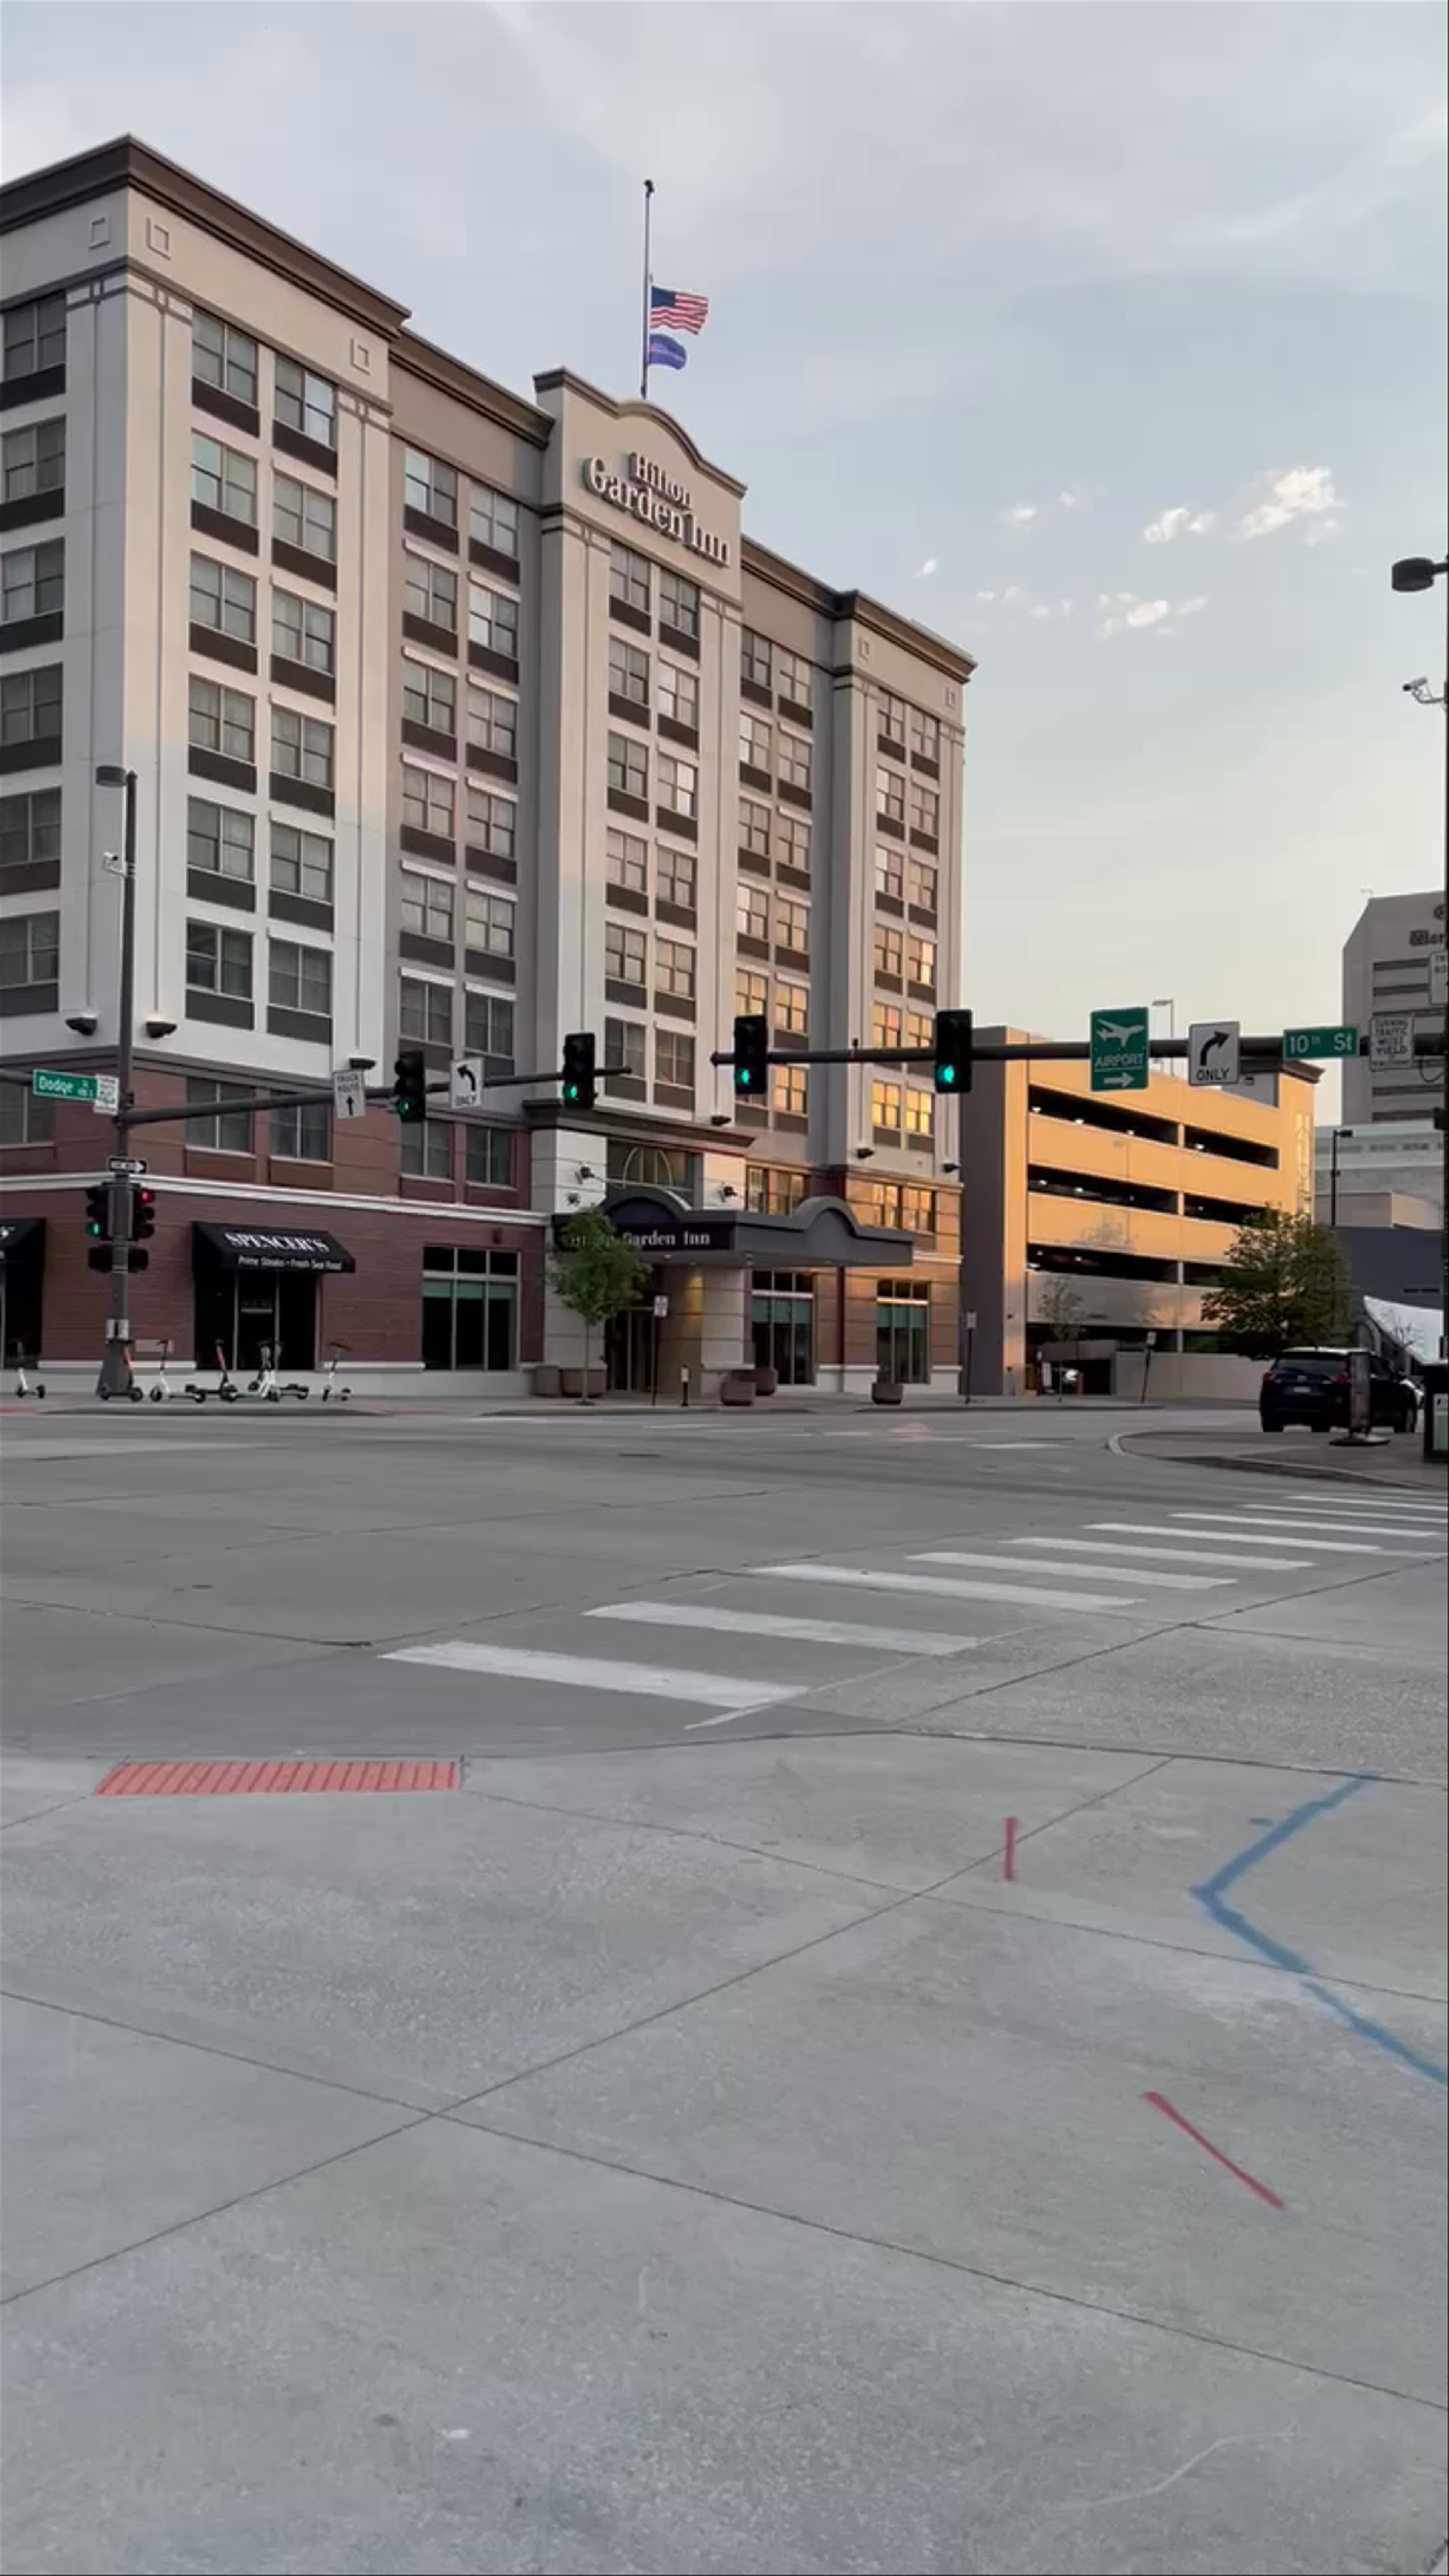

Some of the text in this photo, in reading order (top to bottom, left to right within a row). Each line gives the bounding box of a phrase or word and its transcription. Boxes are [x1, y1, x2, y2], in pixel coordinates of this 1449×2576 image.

[629, 452, 692, 510] Hilton
[584, 456, 730, 567] Garden Inn
[1334, 1033, 1352, 1051] St
[1095, 1053, 1144, 1067] AIRPORT
[1196, 1067, 1229, 1081] ONLY
[39, 1075, 73, 1094] Dodge
[225, 1232, 330, 1252] SPENCER'S
[684, 1230, 711, 1245] Inn
